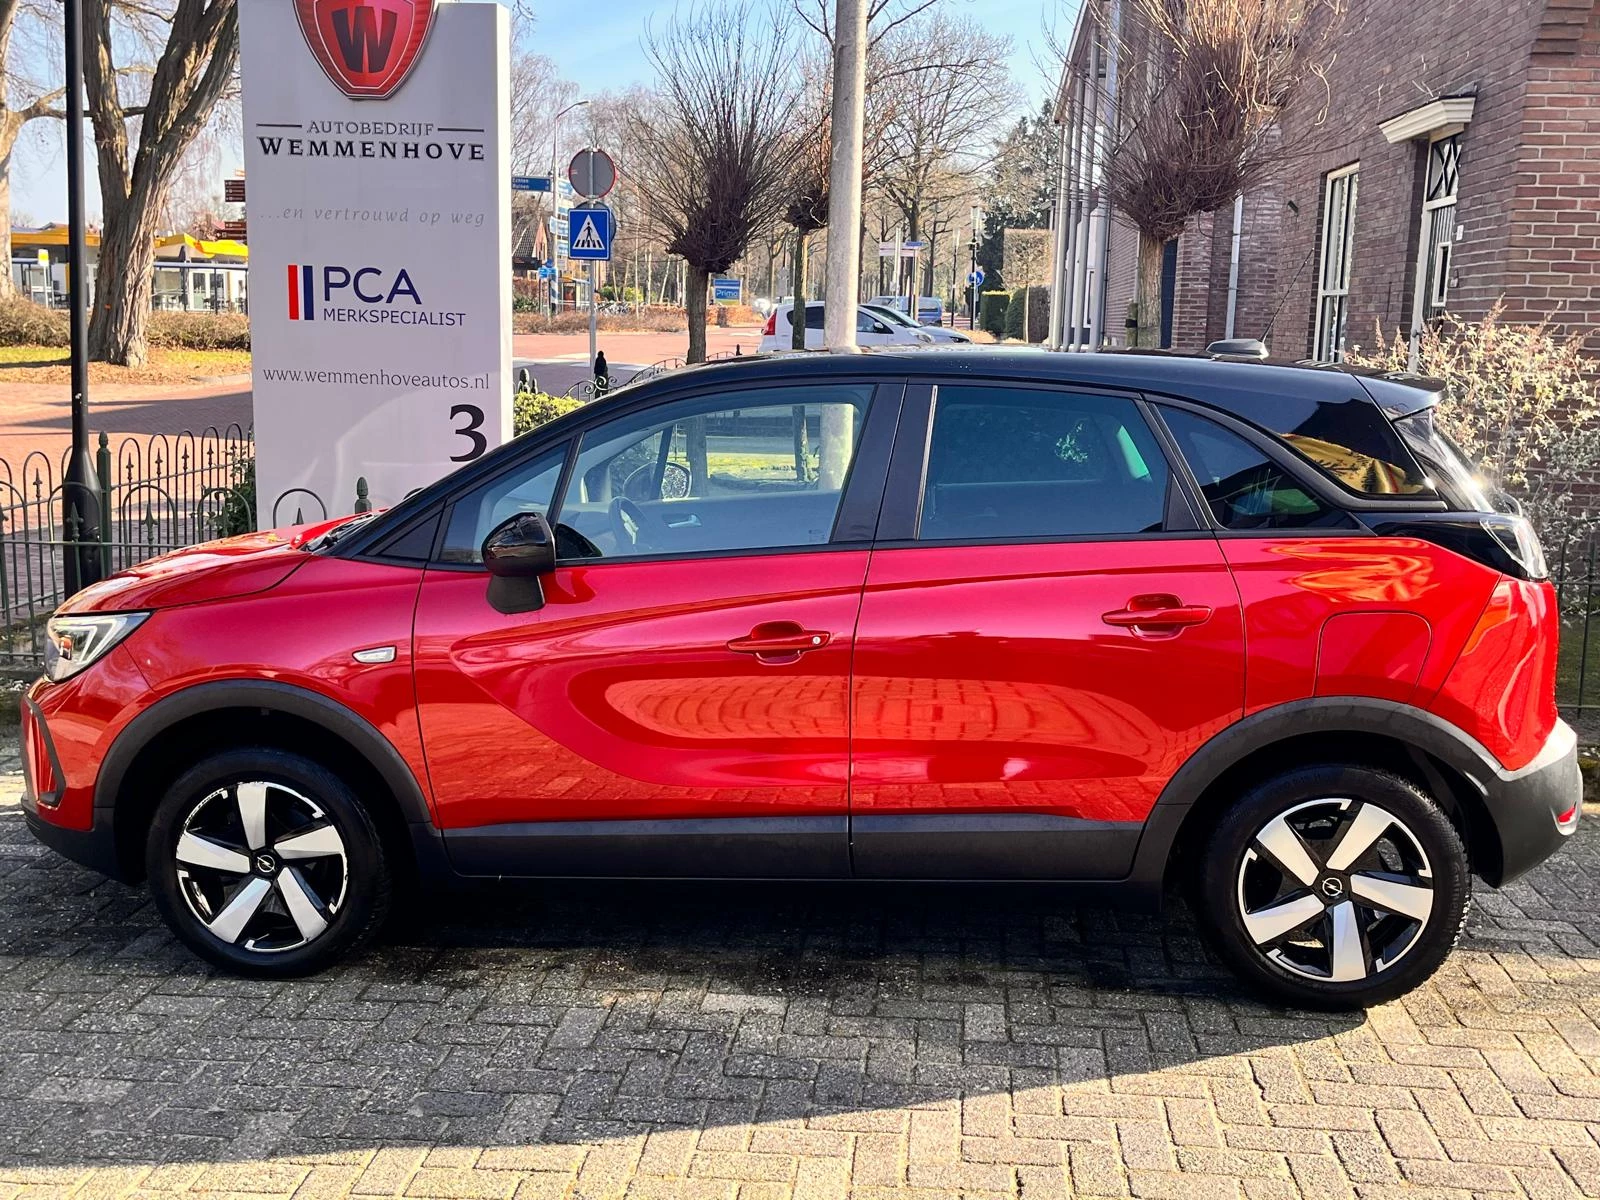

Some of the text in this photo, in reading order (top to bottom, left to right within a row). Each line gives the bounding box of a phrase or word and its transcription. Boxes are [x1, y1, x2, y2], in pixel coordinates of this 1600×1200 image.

[331, 5, 397, 73] W
[307, 120, 434, 137] AUTOBEDRIJF
[256, 136, 485, 161] WEMMENHOVE
[314, 208, 409, 222] vertrouwd
[419, 211, 441, 225] op
[451, 211, 485, 228] weg
[323, 266, 422, 305] PCA
[323, 308, 466, 326] MERKSPECIALIST
[263, 369, 490, 389] www.wemmenhoveautos.nl
[449, 404, 488, 463] 3
